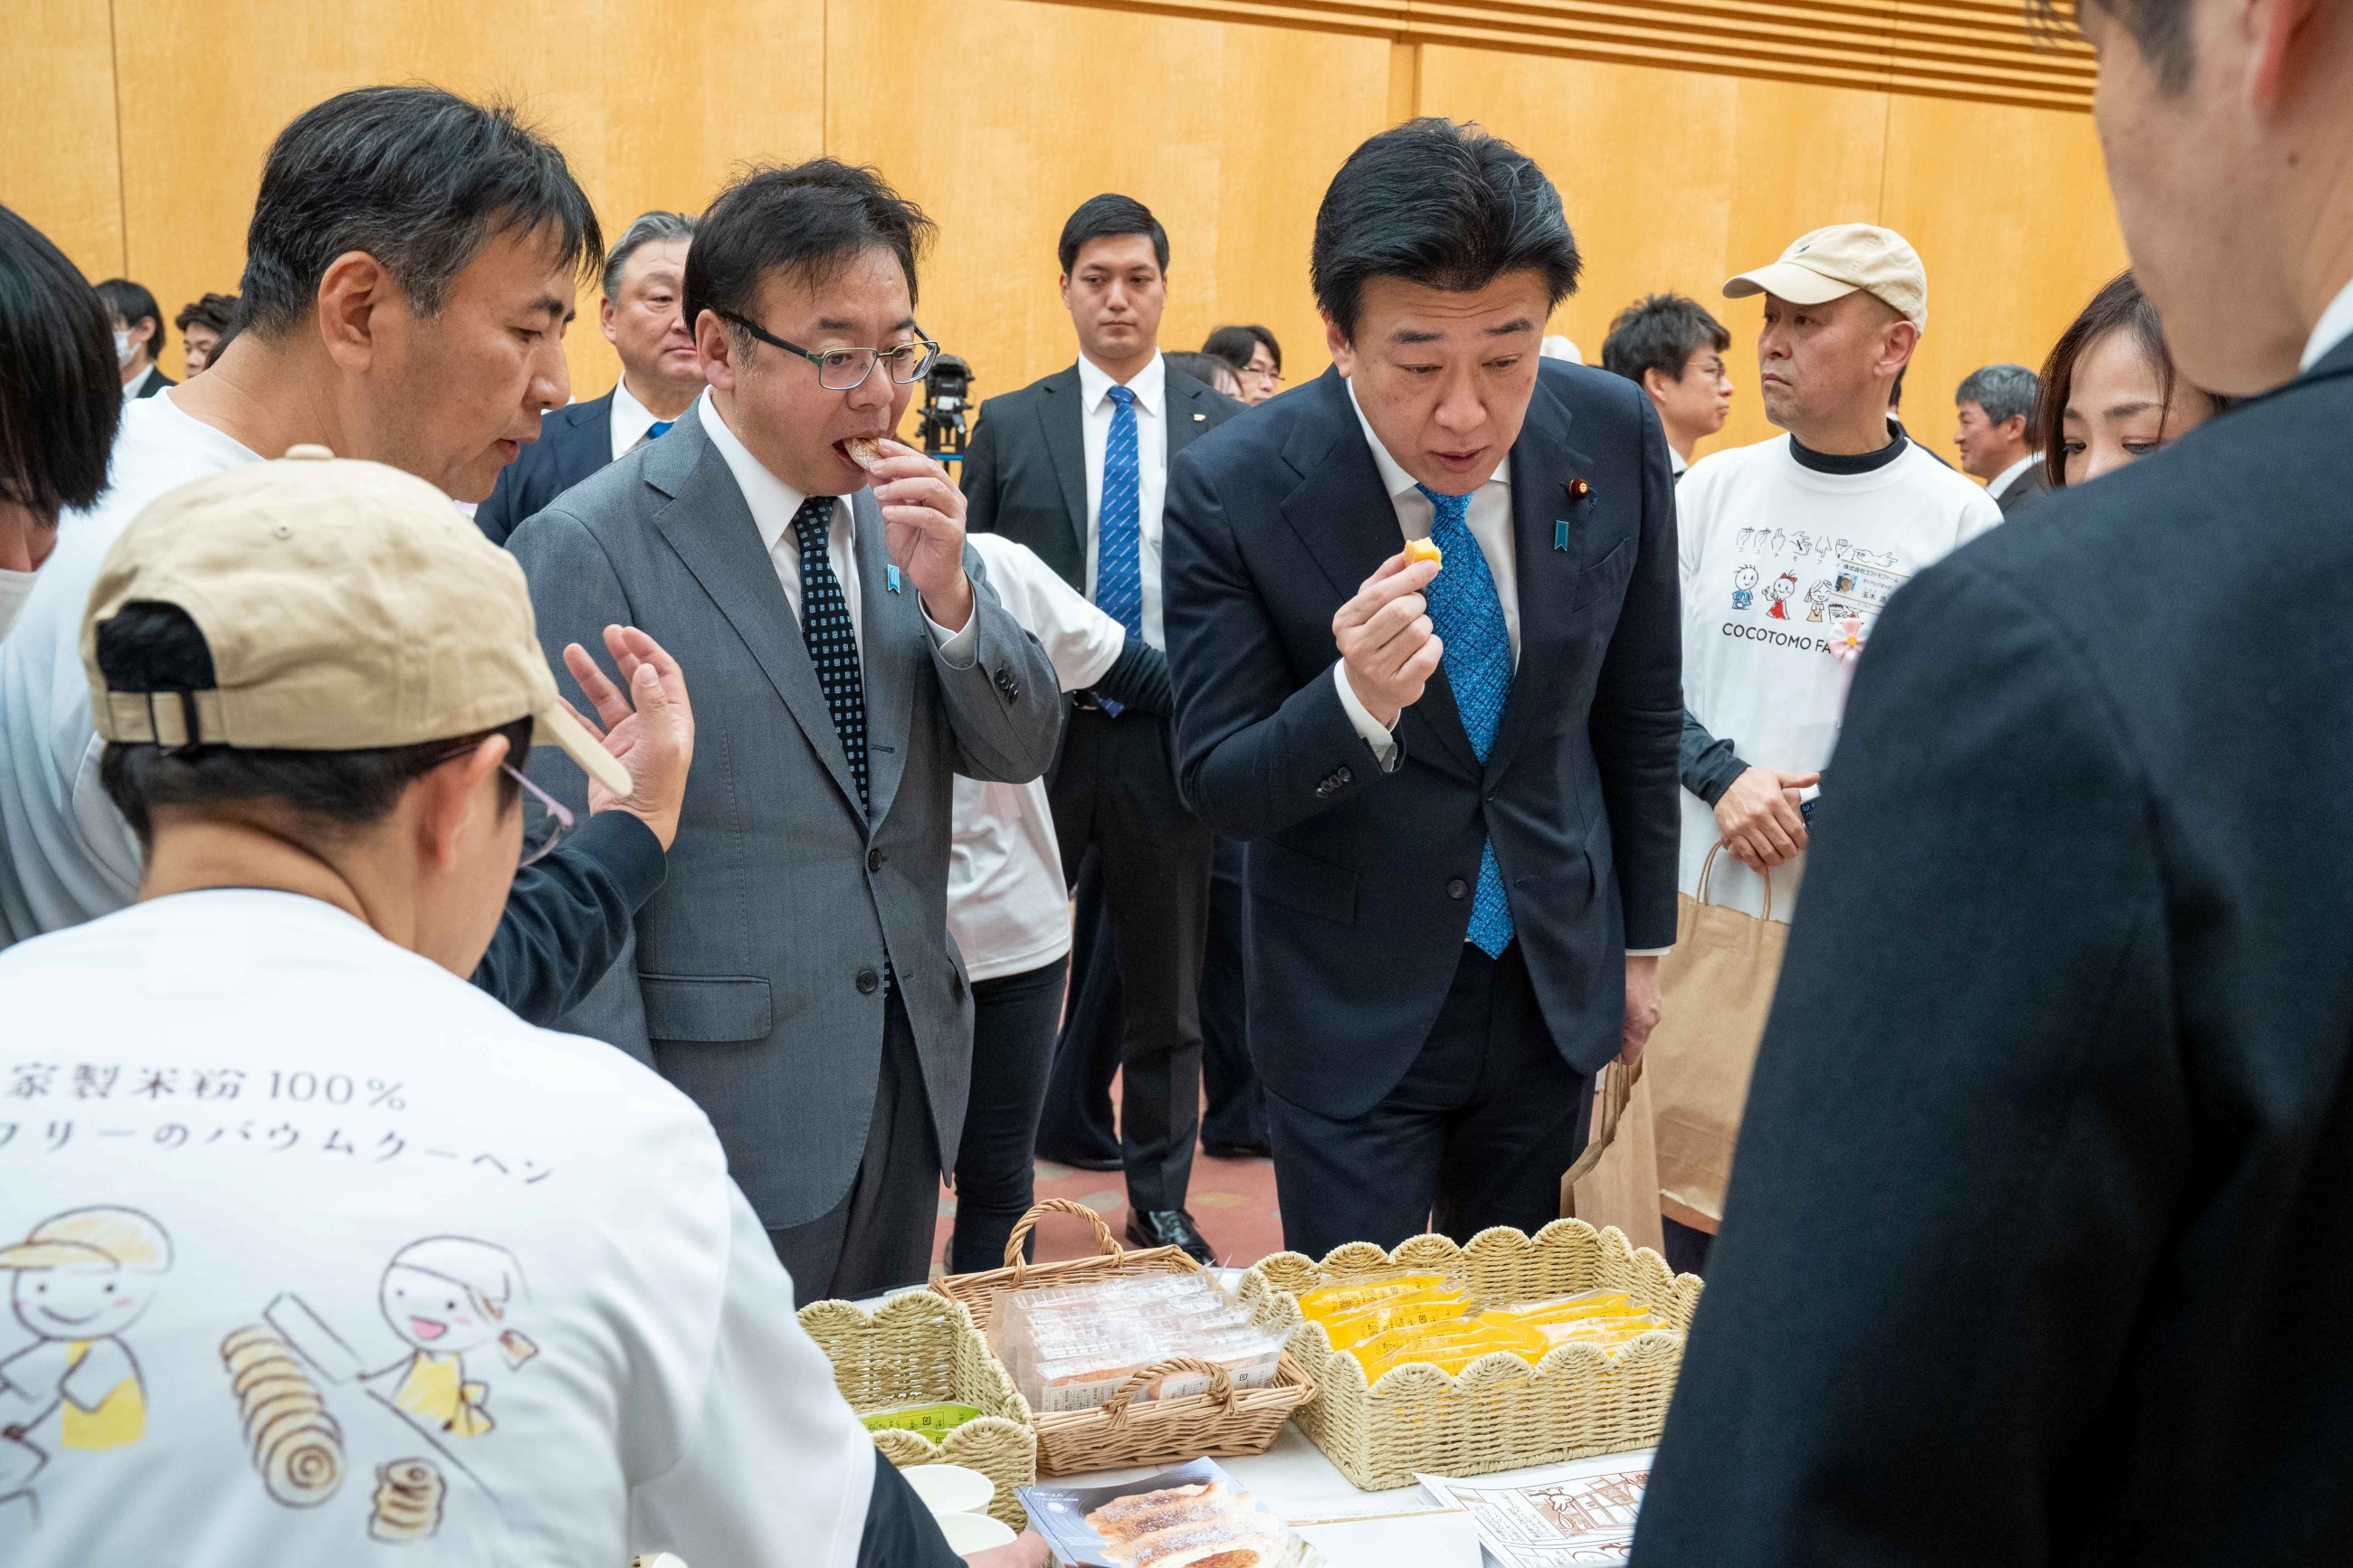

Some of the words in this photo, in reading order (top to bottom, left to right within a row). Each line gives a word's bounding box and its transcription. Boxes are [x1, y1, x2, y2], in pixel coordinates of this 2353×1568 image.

[1843, 564, 1899, 584] 株式会社ココトモファーム
[1722, 622, 1812, 651] COCOTOMO
[1815, 639, 1832, 654] FA
